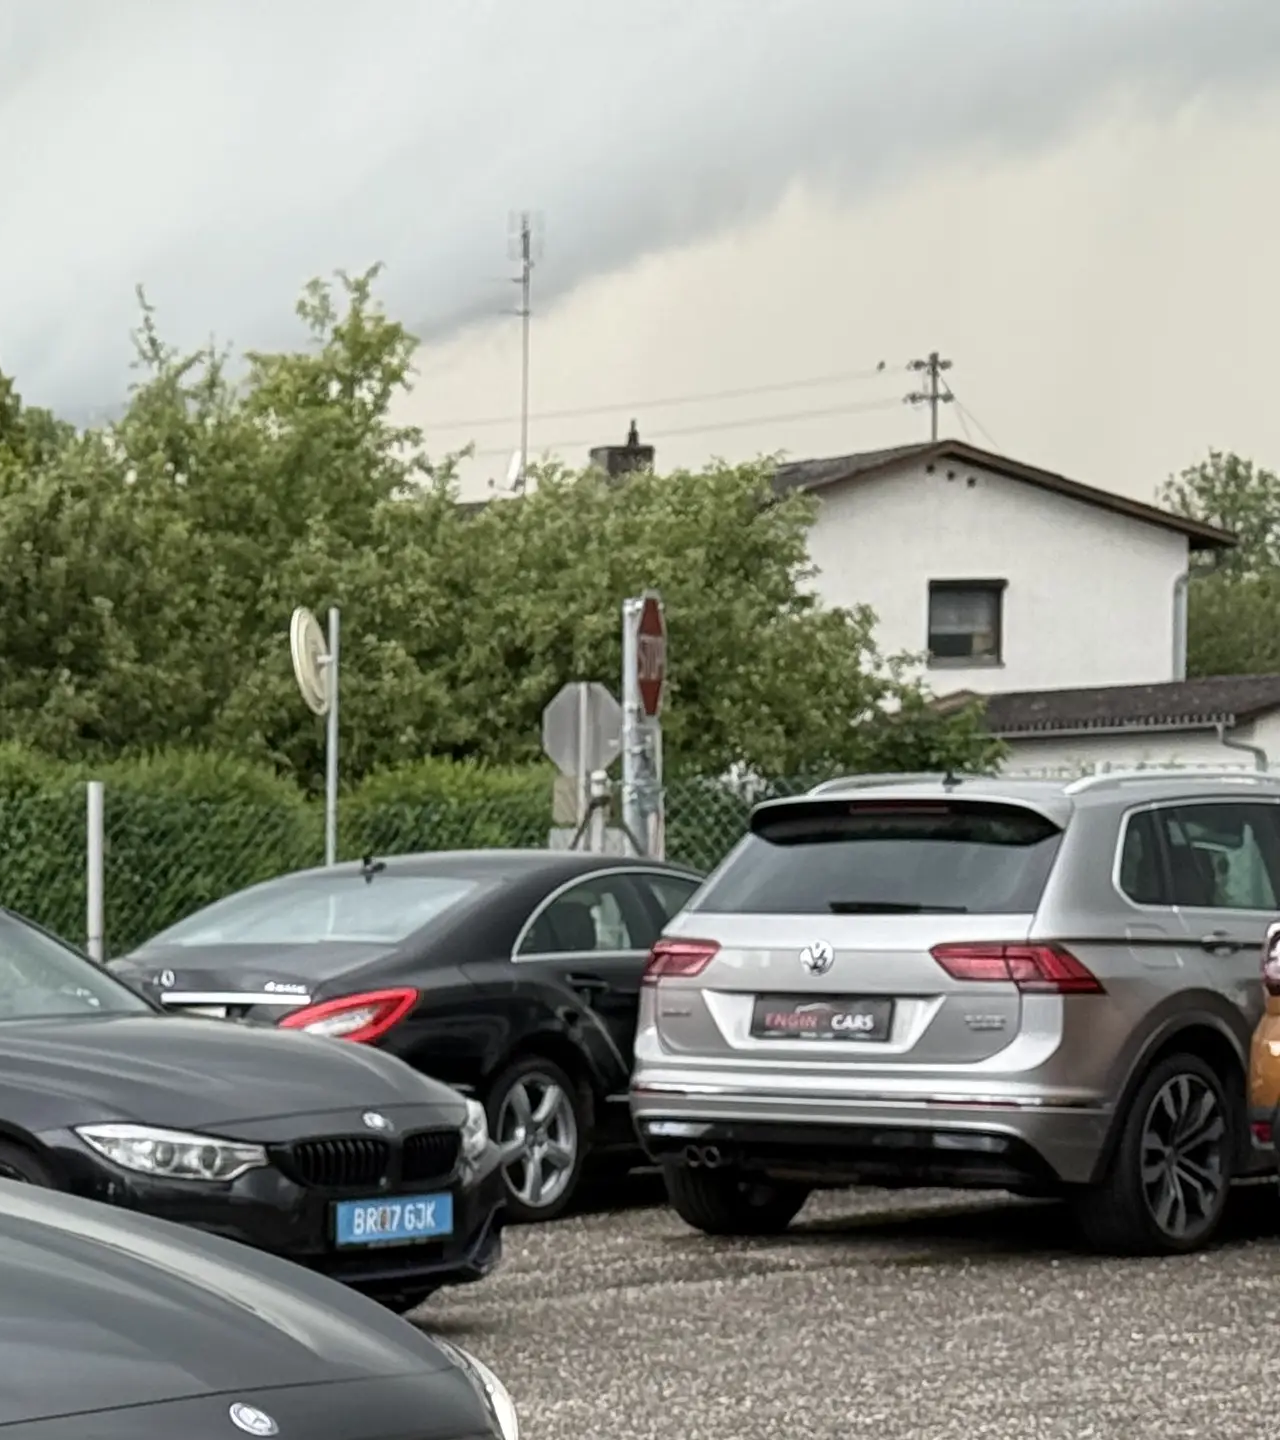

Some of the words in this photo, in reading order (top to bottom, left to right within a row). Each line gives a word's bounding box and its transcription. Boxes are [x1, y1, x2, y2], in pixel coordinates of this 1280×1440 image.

[764, 1011, 818, 1029] ENGIN
[831, 1013, 875, 1031] CARS
[352, 1205, 378, 1236] BR
